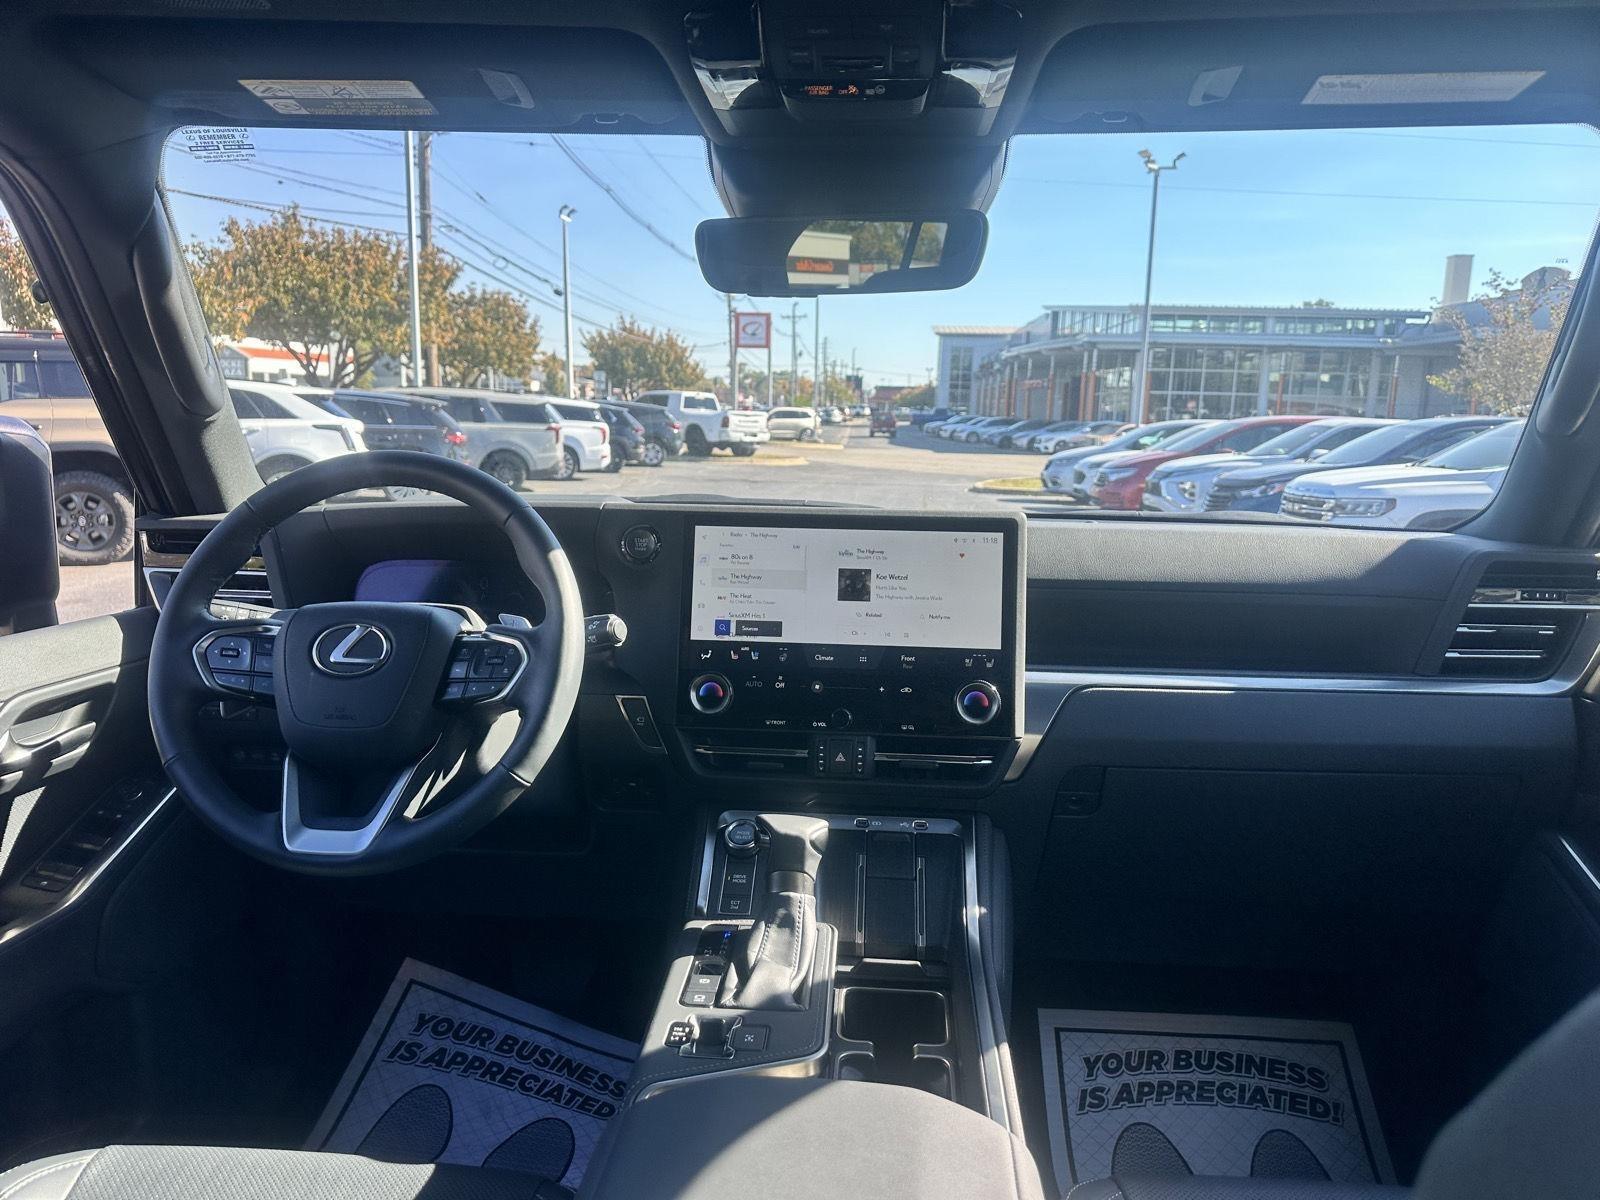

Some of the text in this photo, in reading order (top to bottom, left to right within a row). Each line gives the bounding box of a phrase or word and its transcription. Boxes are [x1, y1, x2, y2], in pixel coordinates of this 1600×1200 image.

[740, 573, 763, 581] Highway
[888, 573, 909, 581] Wetzel
[928, 613, 943, 621] Notify
[900, 654, 916, 662] Front
[745, 680, 763, 688] AUTO
[384, 1039, 423, 1064] IS
[409, 1011, 628, 1099] YOUR BUSINESS
[1081, 1049, 1330, 1092] YOUR BUSINESS
[1076, 1079, 1344, 1124] IS APPRECIATED!
